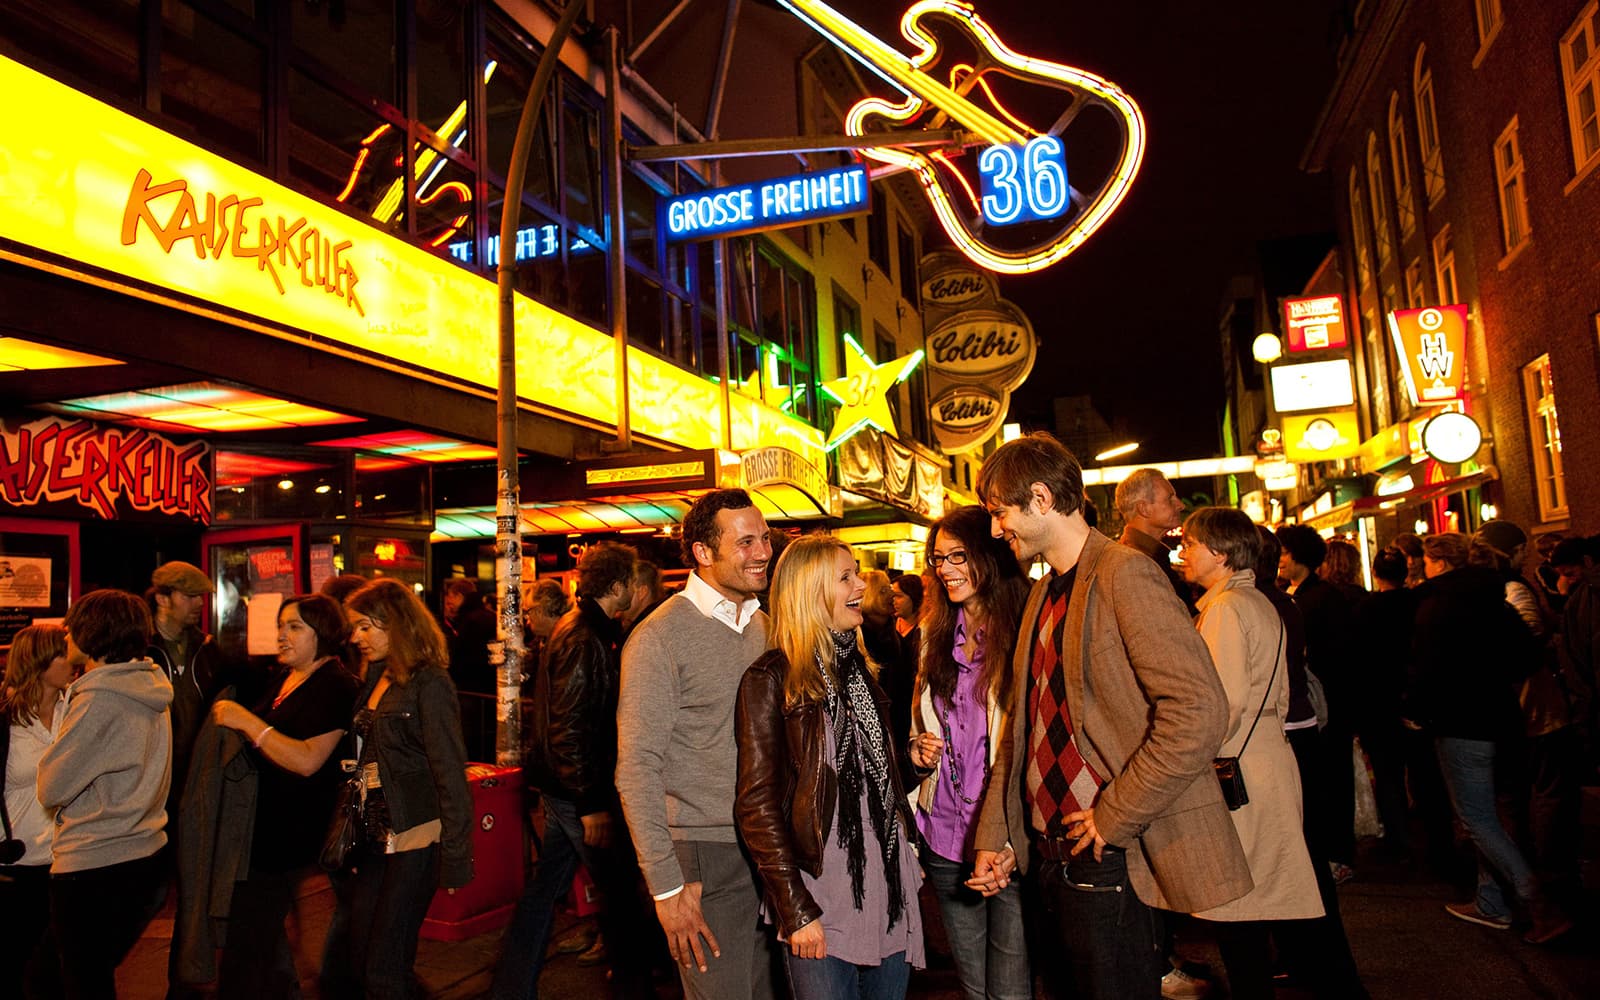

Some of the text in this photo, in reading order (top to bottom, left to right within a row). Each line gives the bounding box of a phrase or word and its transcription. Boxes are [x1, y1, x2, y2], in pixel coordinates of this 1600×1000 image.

[979, 134, 1067, 225] 36
[667, 168, 865, 233] GROSSE FREIHEIT
[121, 167, 365, 318] KAISERKELLER
[929, 275, 984, 299] Colibri
[932, 330, 1021, 363] Colibri
[847, 373, 877, 408] 36
[940, 400, 994, 422] Colibri
[744, 450, 780, 484] GROSSE
[782, 451, 815, 490] FREIHEIT
